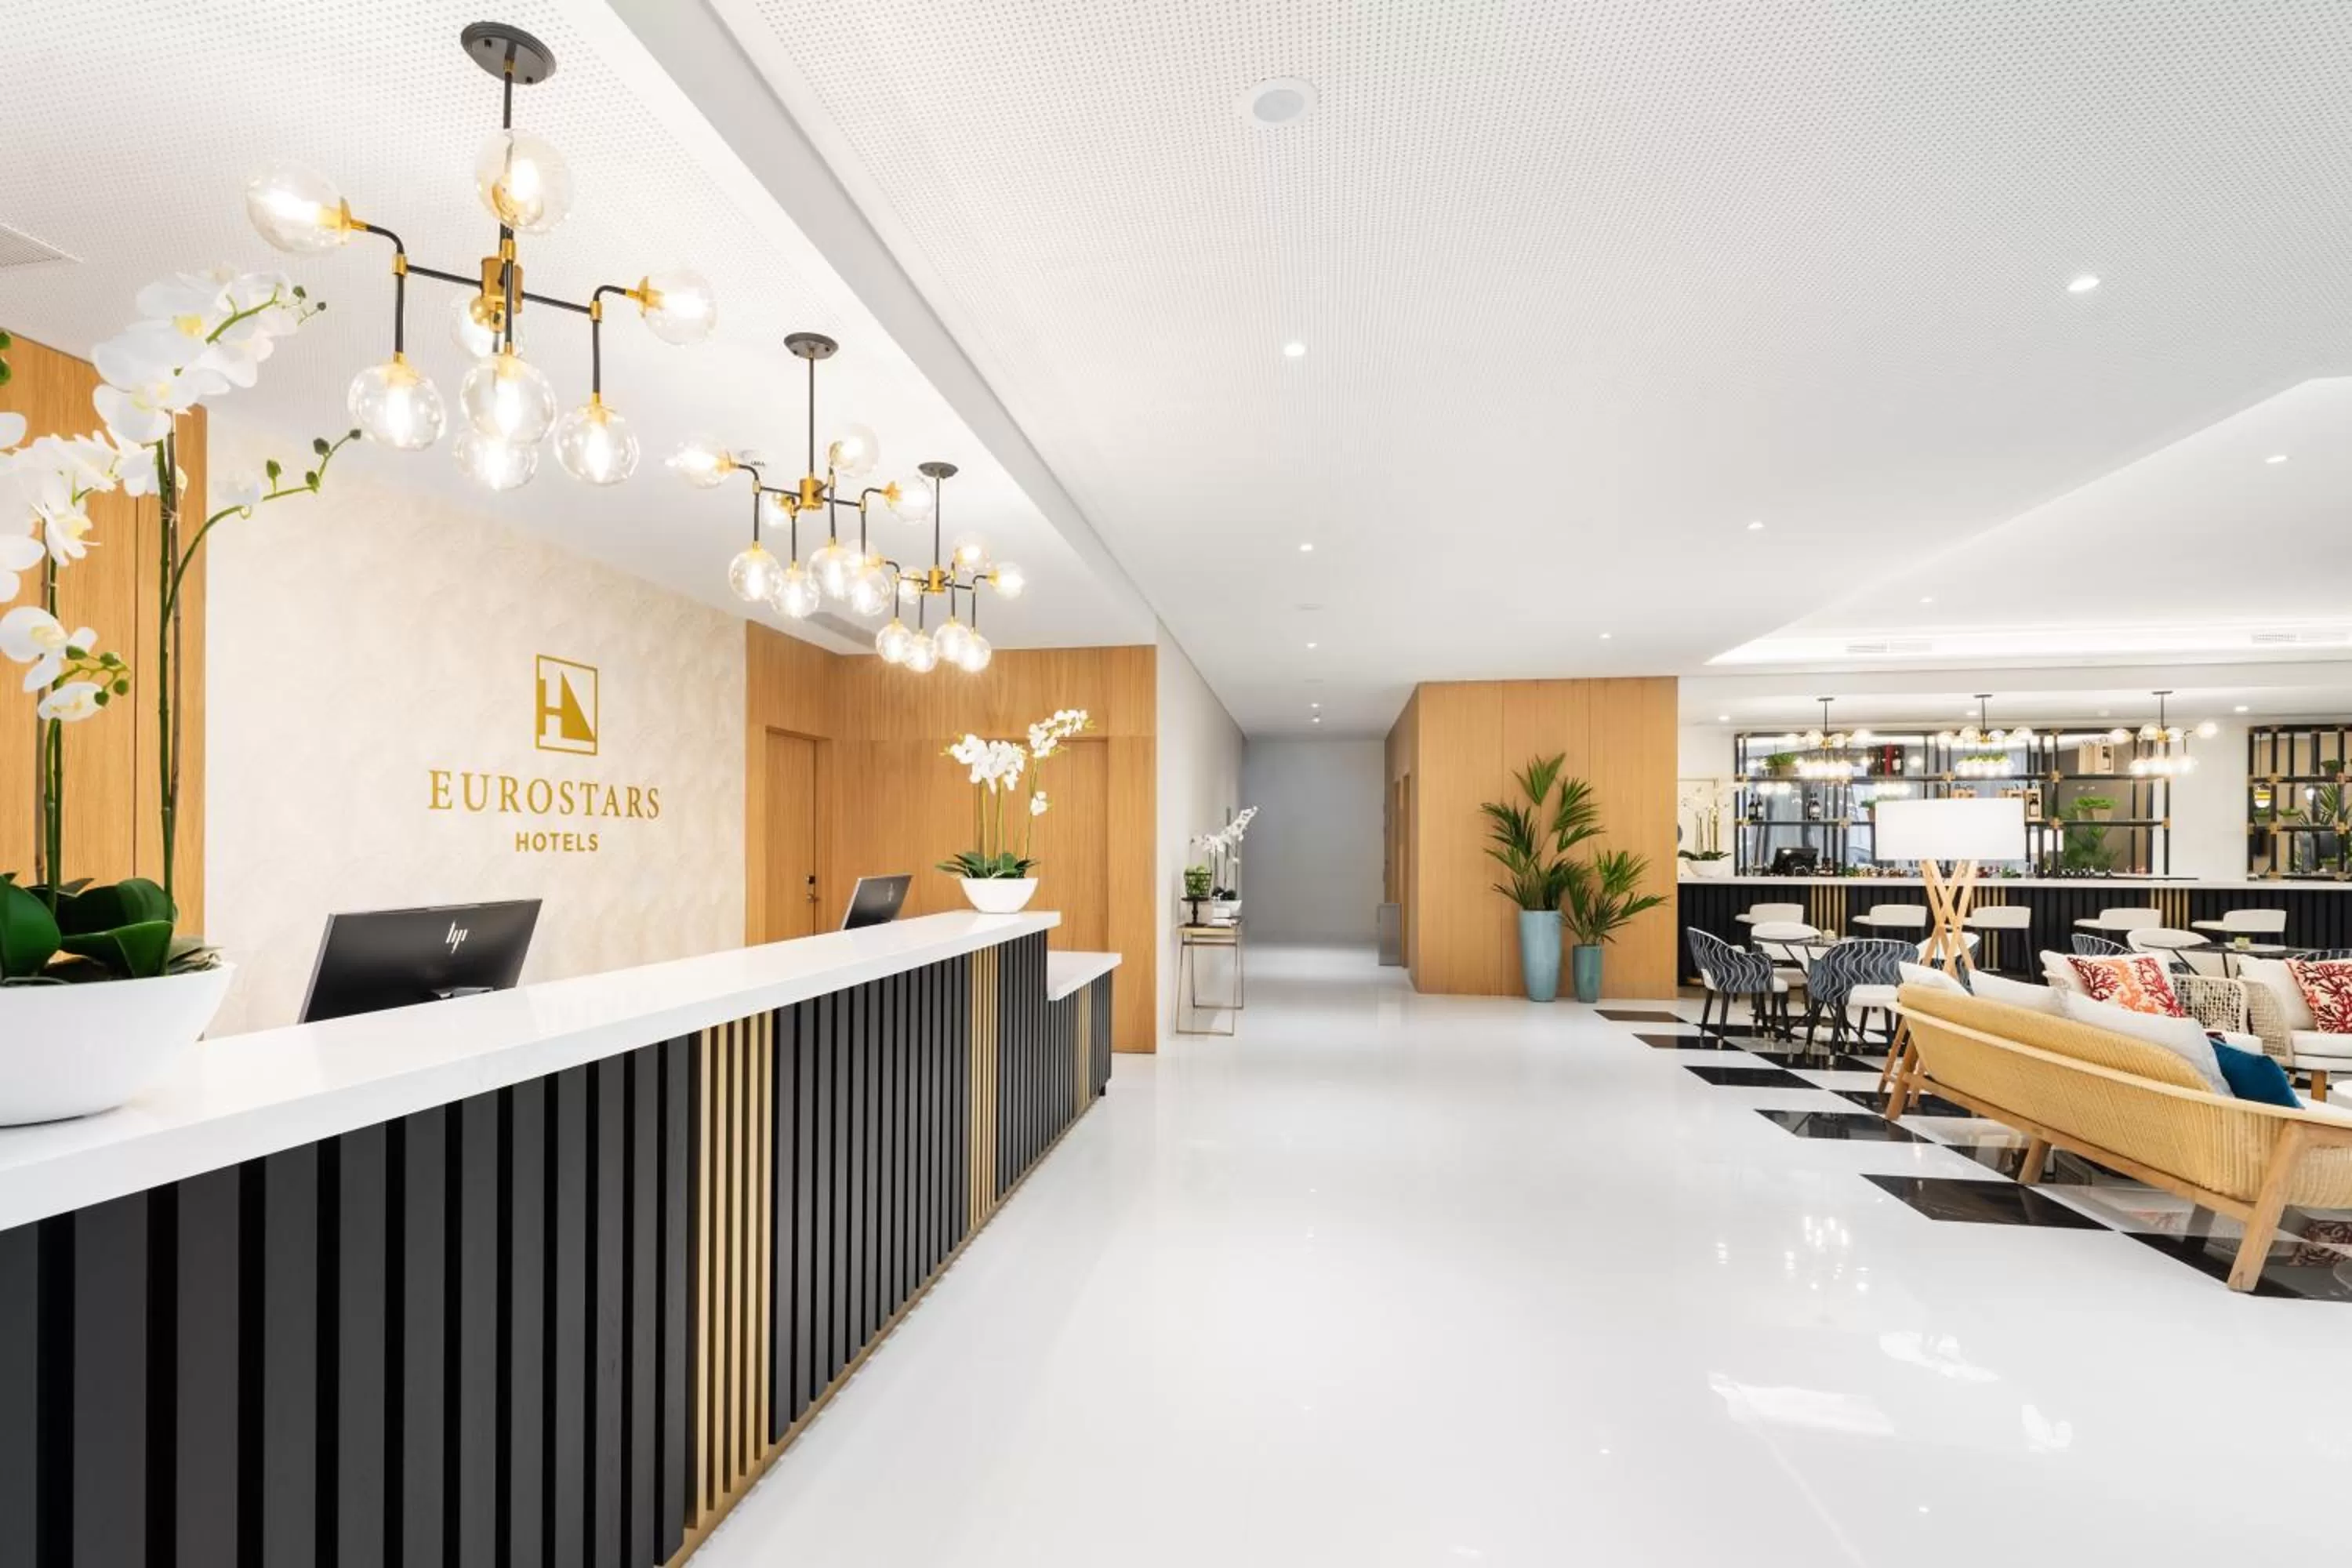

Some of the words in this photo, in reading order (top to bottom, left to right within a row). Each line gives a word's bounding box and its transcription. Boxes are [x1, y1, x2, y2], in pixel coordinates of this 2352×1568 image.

[428, 769, 660, 819] EUROSTARS
[515, 832, 599, 852] HOTELS
[445, 920, 468, 954] hp
